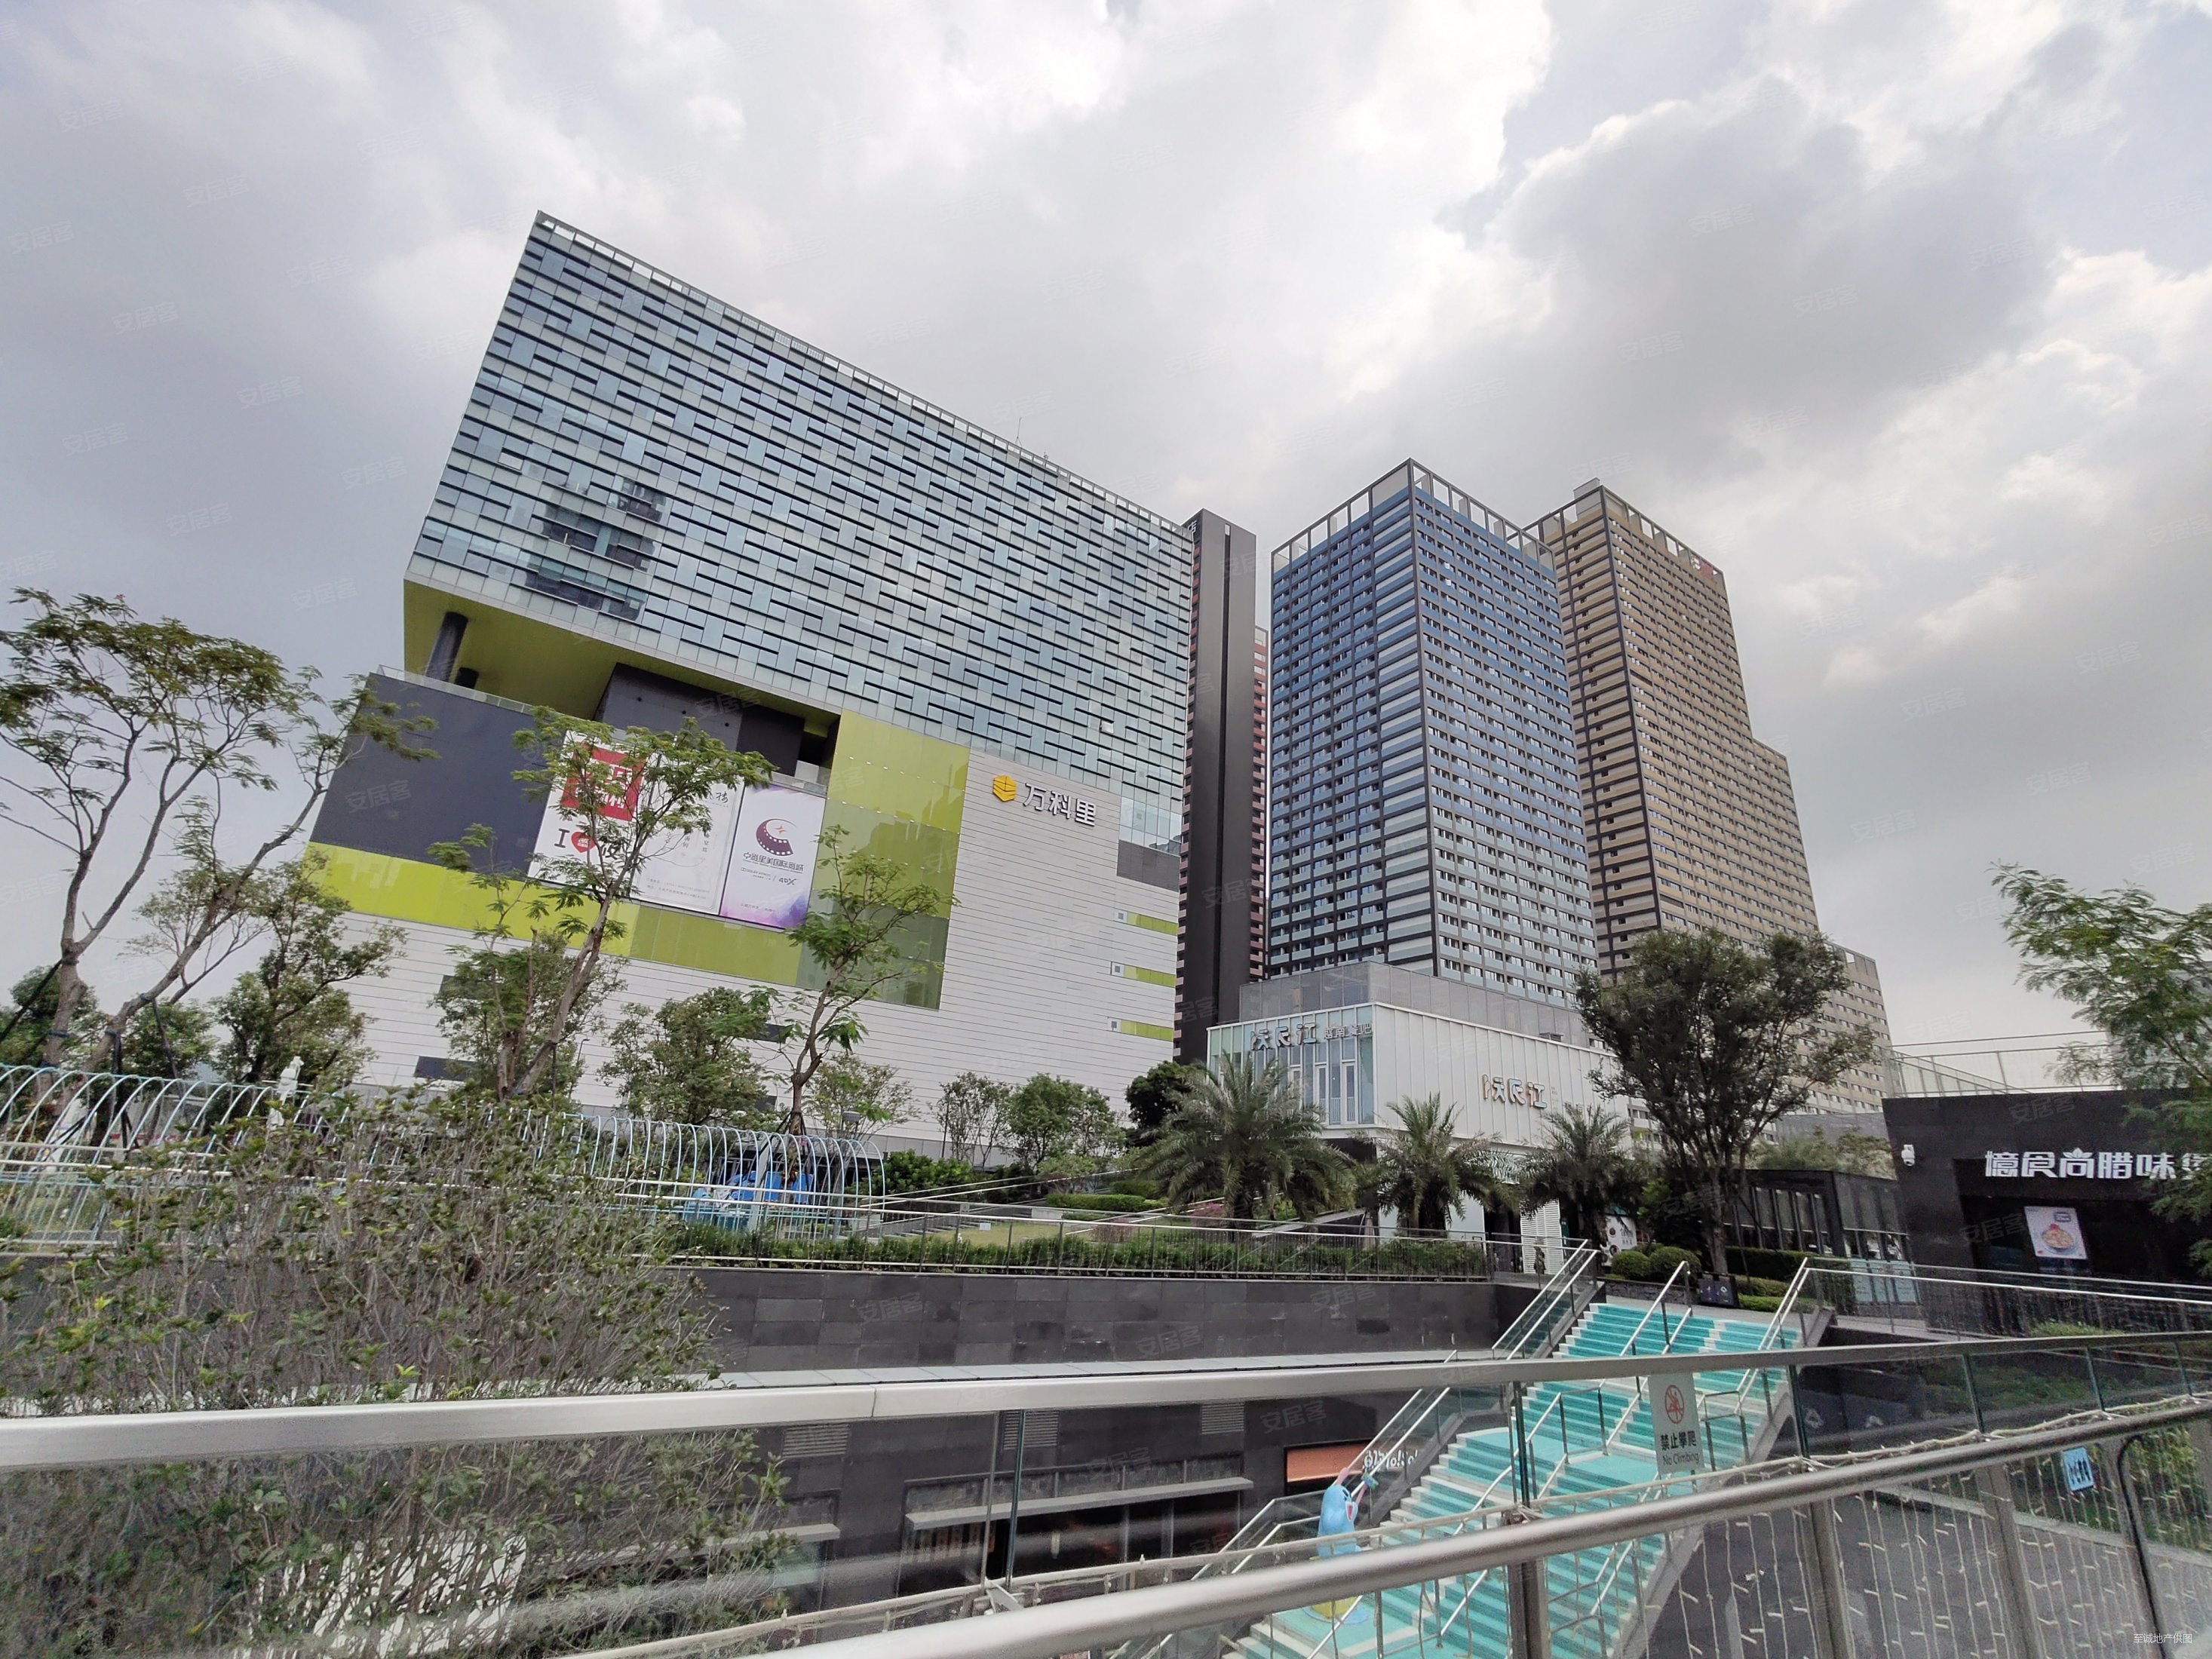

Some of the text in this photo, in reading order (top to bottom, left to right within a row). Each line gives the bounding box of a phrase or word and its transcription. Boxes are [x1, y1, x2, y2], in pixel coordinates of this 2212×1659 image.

[1023, 783, 1097, 826] 万科里
[1660, 1431, 1697, 1451] 禁止攀爬
[1662, 1452, 1700, 1465] No Climbing
